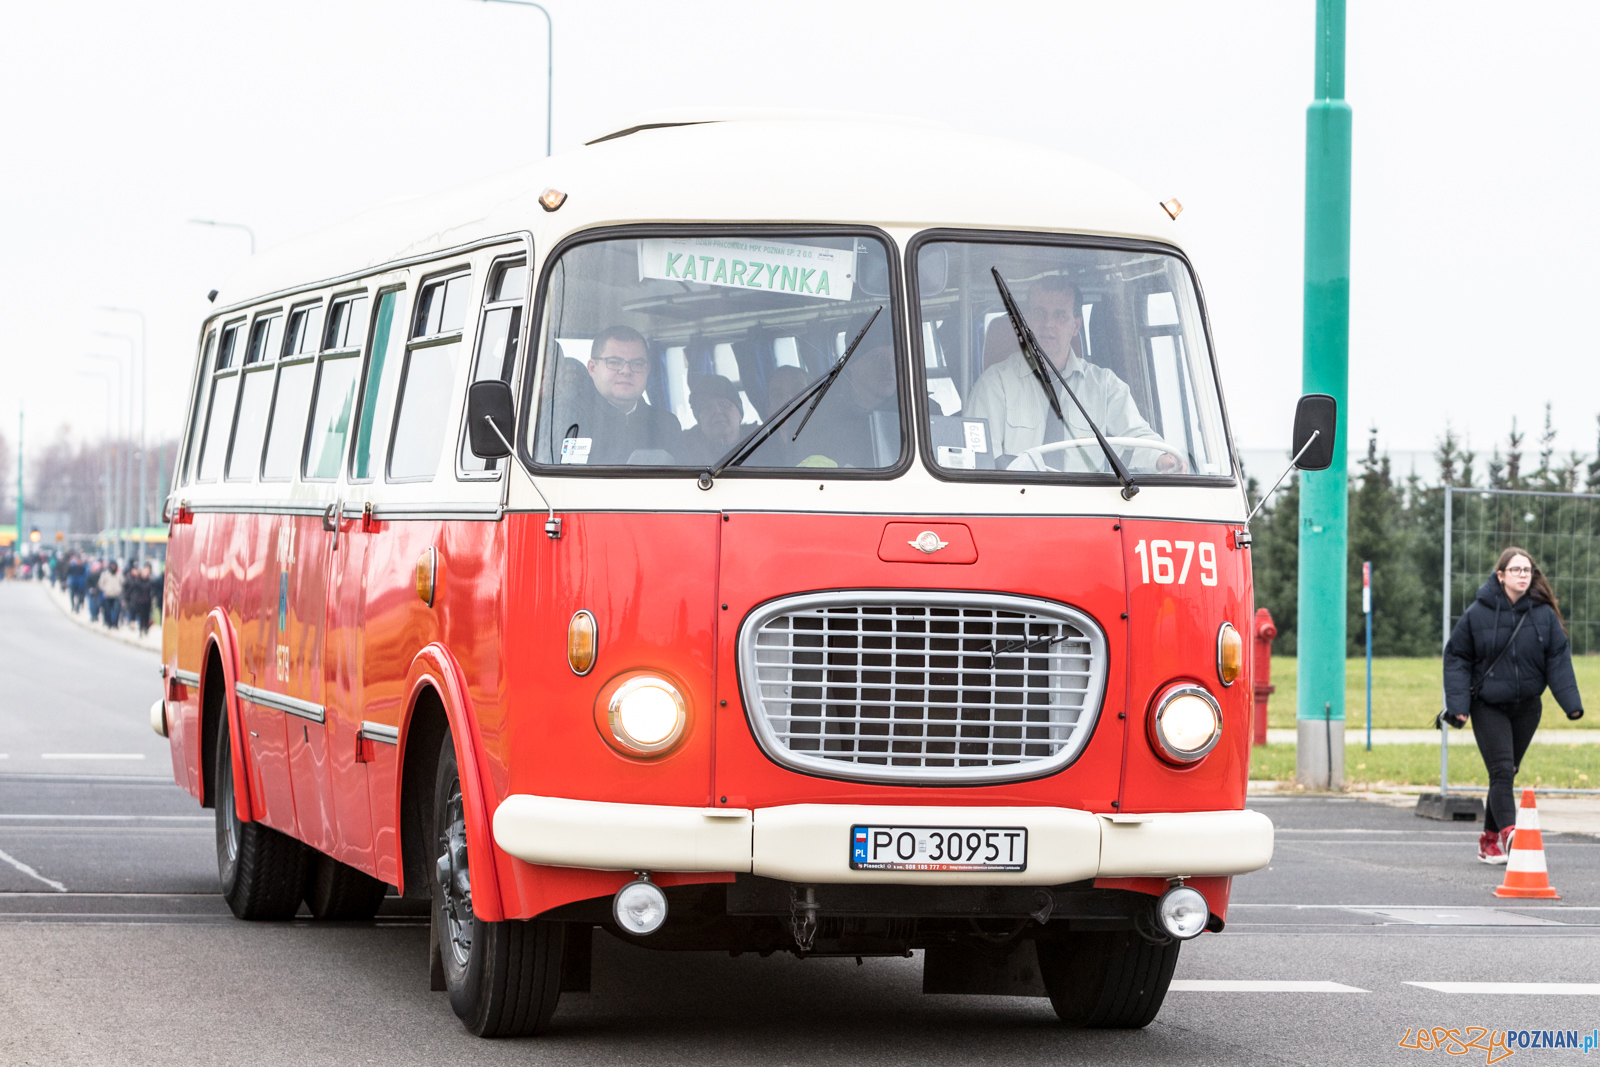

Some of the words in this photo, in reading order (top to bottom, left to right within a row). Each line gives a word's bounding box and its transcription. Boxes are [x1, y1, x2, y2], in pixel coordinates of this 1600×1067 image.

[749, 244, 762, 253] MPK
[763, 245, 785, 256] POZNAŃ
[665, 251, 830, 296] KATARZYNKA
[969, 425, 982, 449] 1679
[1134, 539, 1218, 587] 1679
[855, 849, 866, 858] PL
[873, 831, 915, 860] PO
[928, 832, 1021, 862] 3095T
